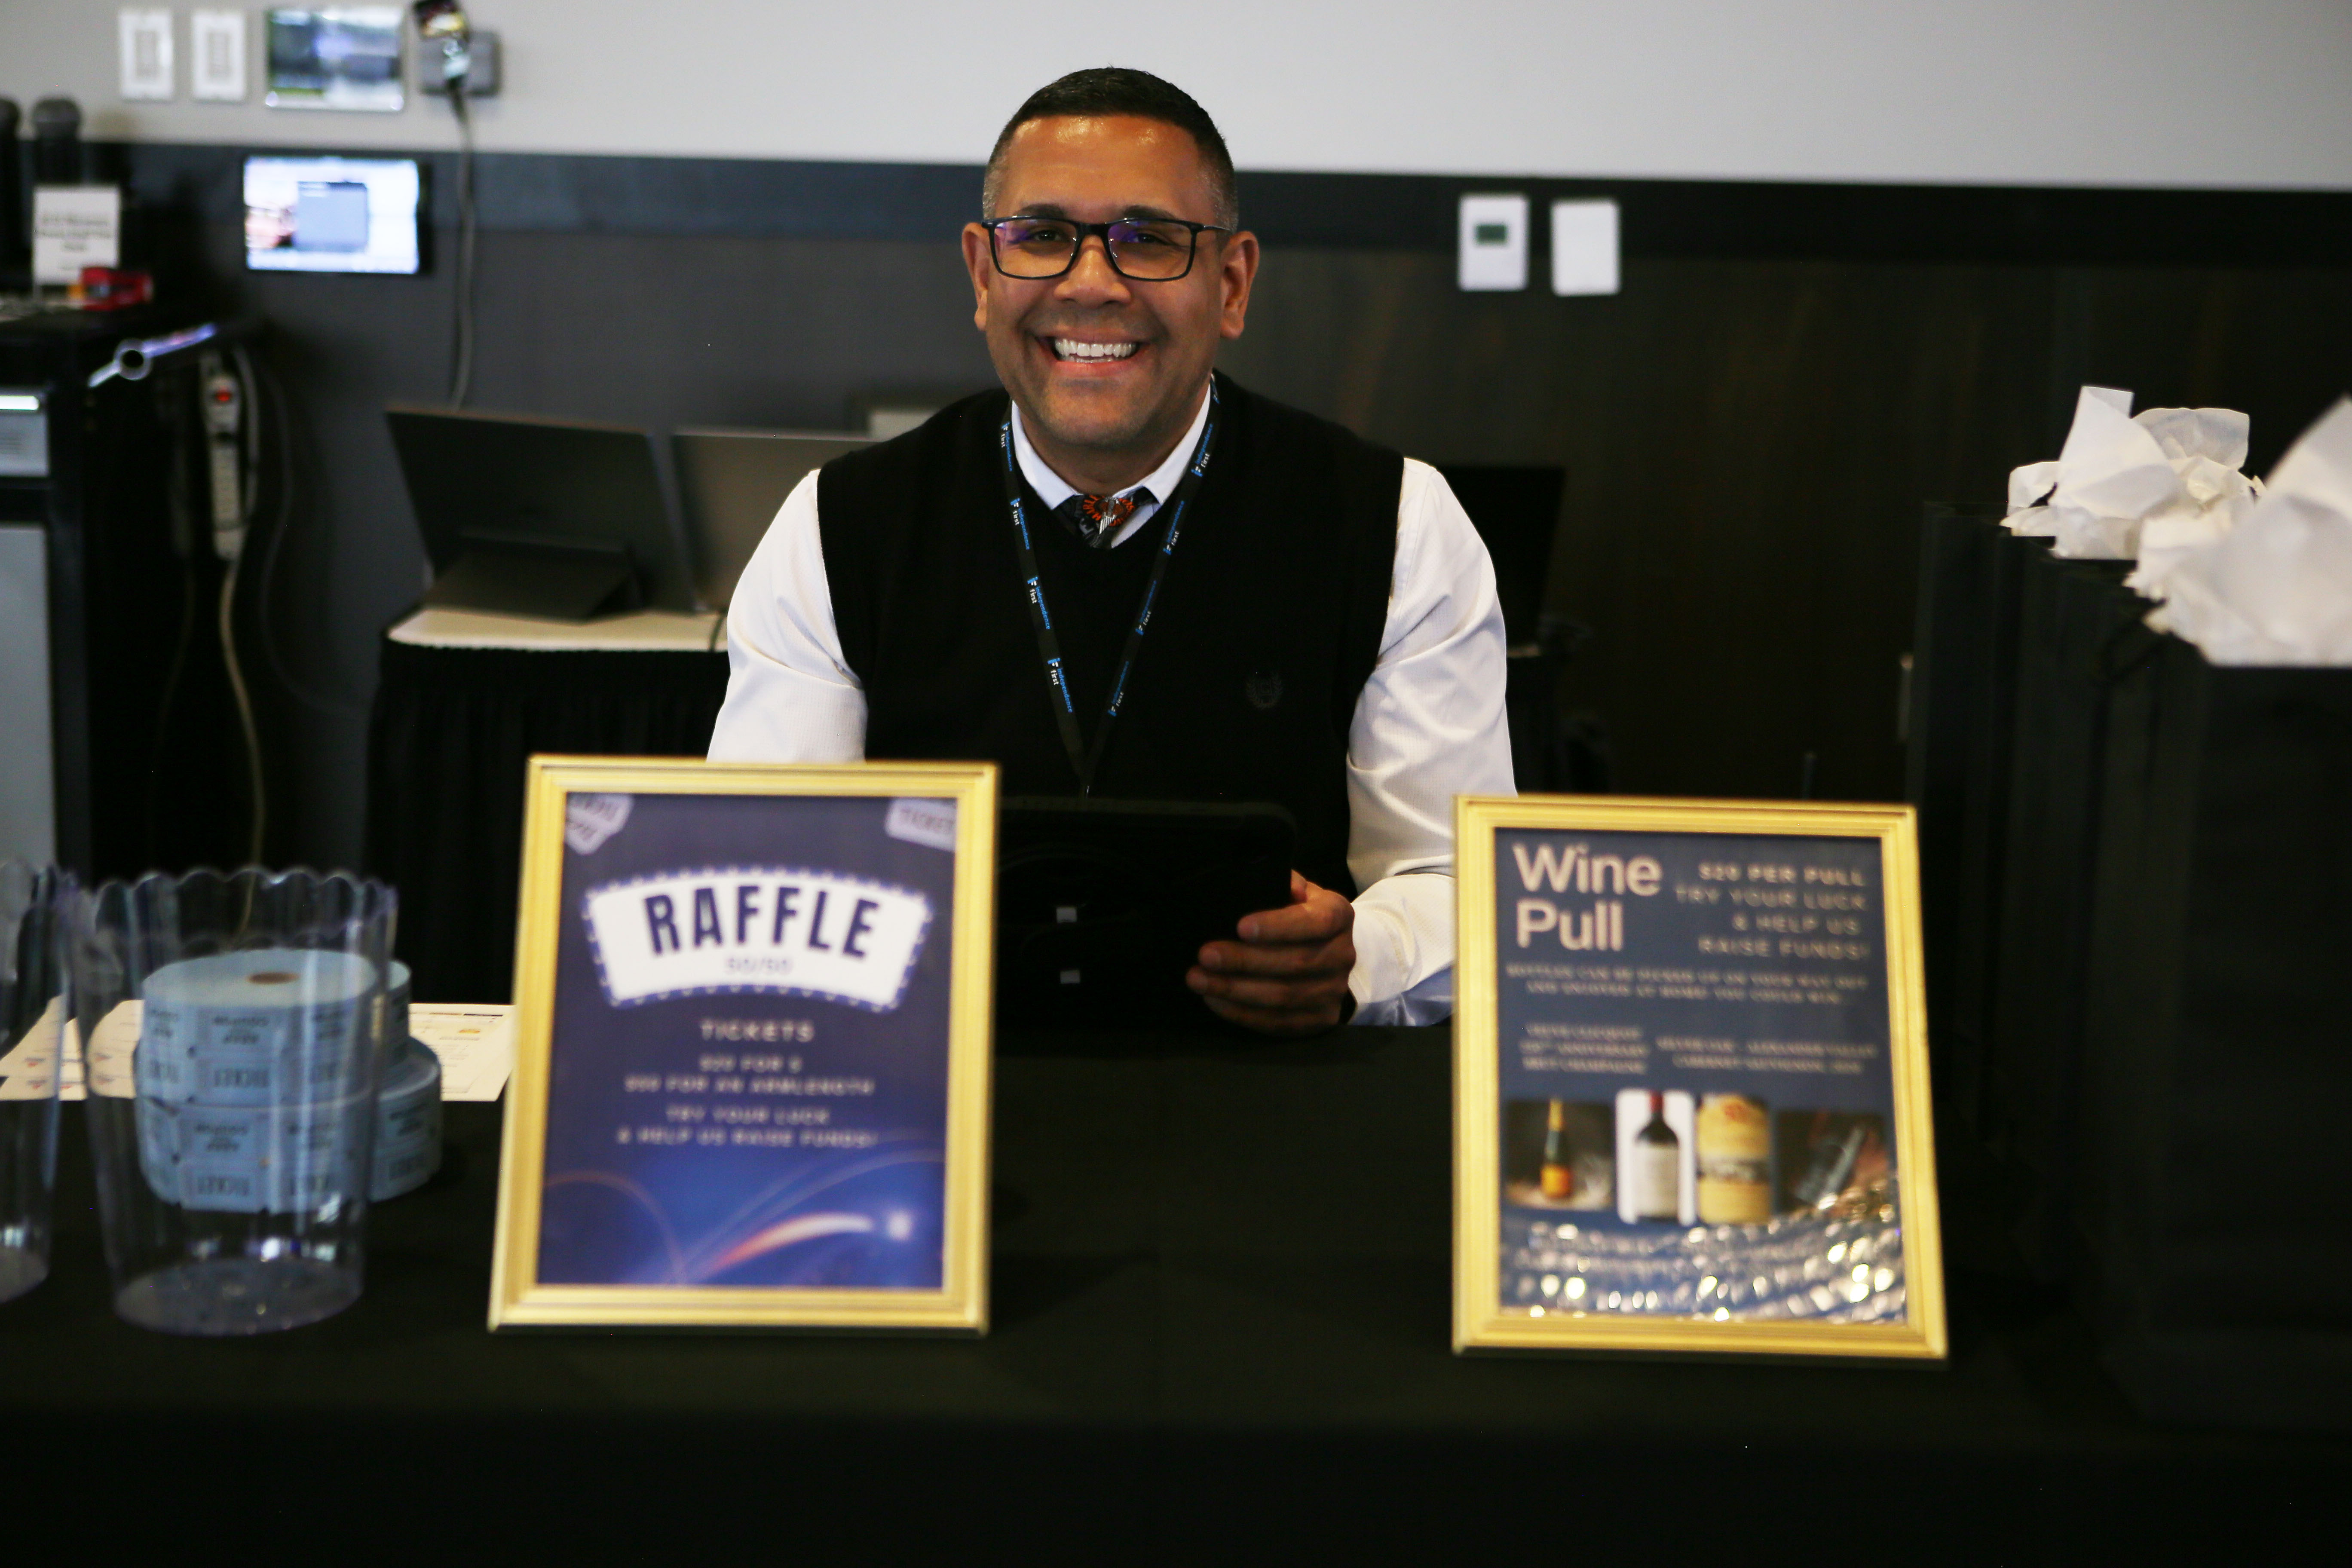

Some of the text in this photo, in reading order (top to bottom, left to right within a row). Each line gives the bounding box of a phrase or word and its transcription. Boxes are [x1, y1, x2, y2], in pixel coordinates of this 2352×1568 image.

[1200, 453, 1210, 468] first
[1018, 507, 1030, 550] independence
[1171, 531, 1179, 545] first
[1036, 585, 1050, 630] independence
[1143, 611, 1151, 625] first
[1050, 670, 1059, 685] first
[1057, 668, 1072, 713] independence
[1513, 843, 1662, 896] Wine
[1747, 863, 1798, 883] PER
[1804, 865, 1865, 886] PULL
[1730, 887, 1798, 907] YOUR
[1804, 890, 1868, 911] LUCK
[643, 885, 879, 961] RAFFLE
[1516, 899, 1623, 951] Pull
[725, 957, 793, 975] 50/50
[700, 1019, 815, 1042] TICKETS
